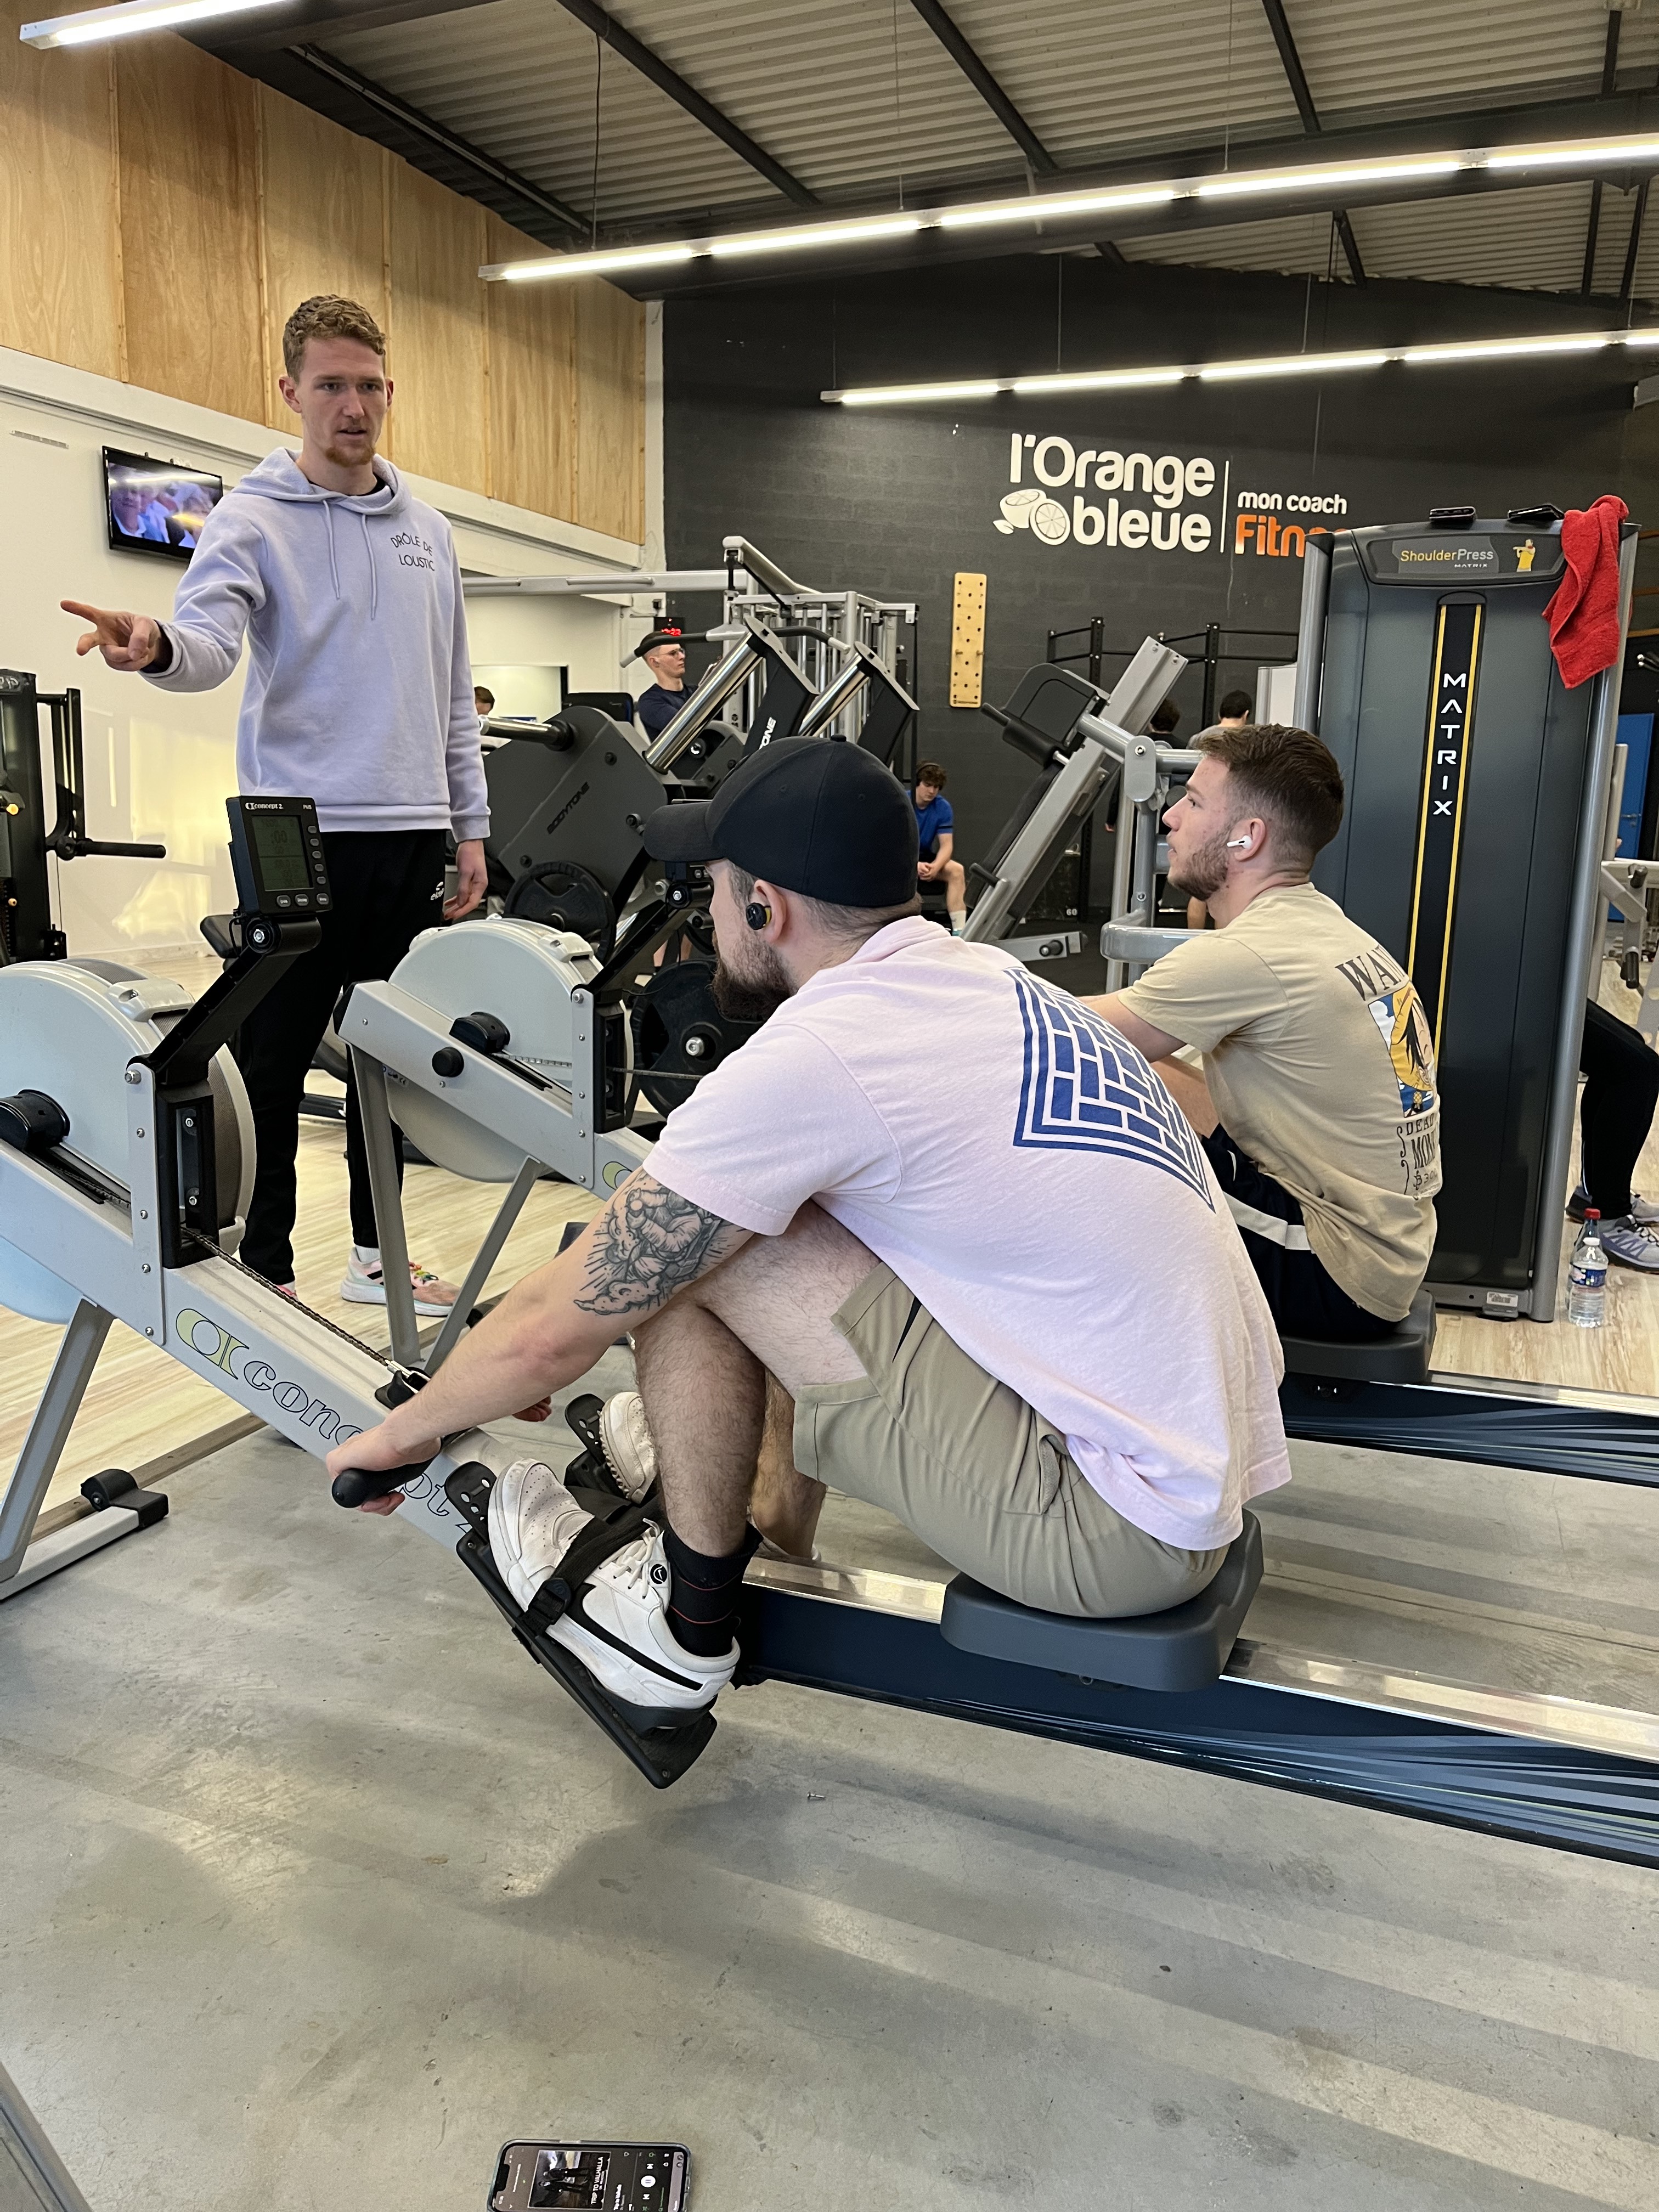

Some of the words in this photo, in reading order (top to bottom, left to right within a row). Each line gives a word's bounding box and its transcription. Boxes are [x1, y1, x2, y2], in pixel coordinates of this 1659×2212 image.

[1010, 433, 1215, 509] l'Orange
[1238, 492, 1282, 510] mon
[1286, 494, 1347, 515] coach
[1073, 496, 1212, 552] bleue
[399, 554, 435, 571] LOUSTIC
[423, 541, 432, 556] DE
[1433, 673, 1466, 815] MATRIX
[547, 782, 590, 834] BODYTONE
[1406, 1113, 1434, 1136] DEAD
